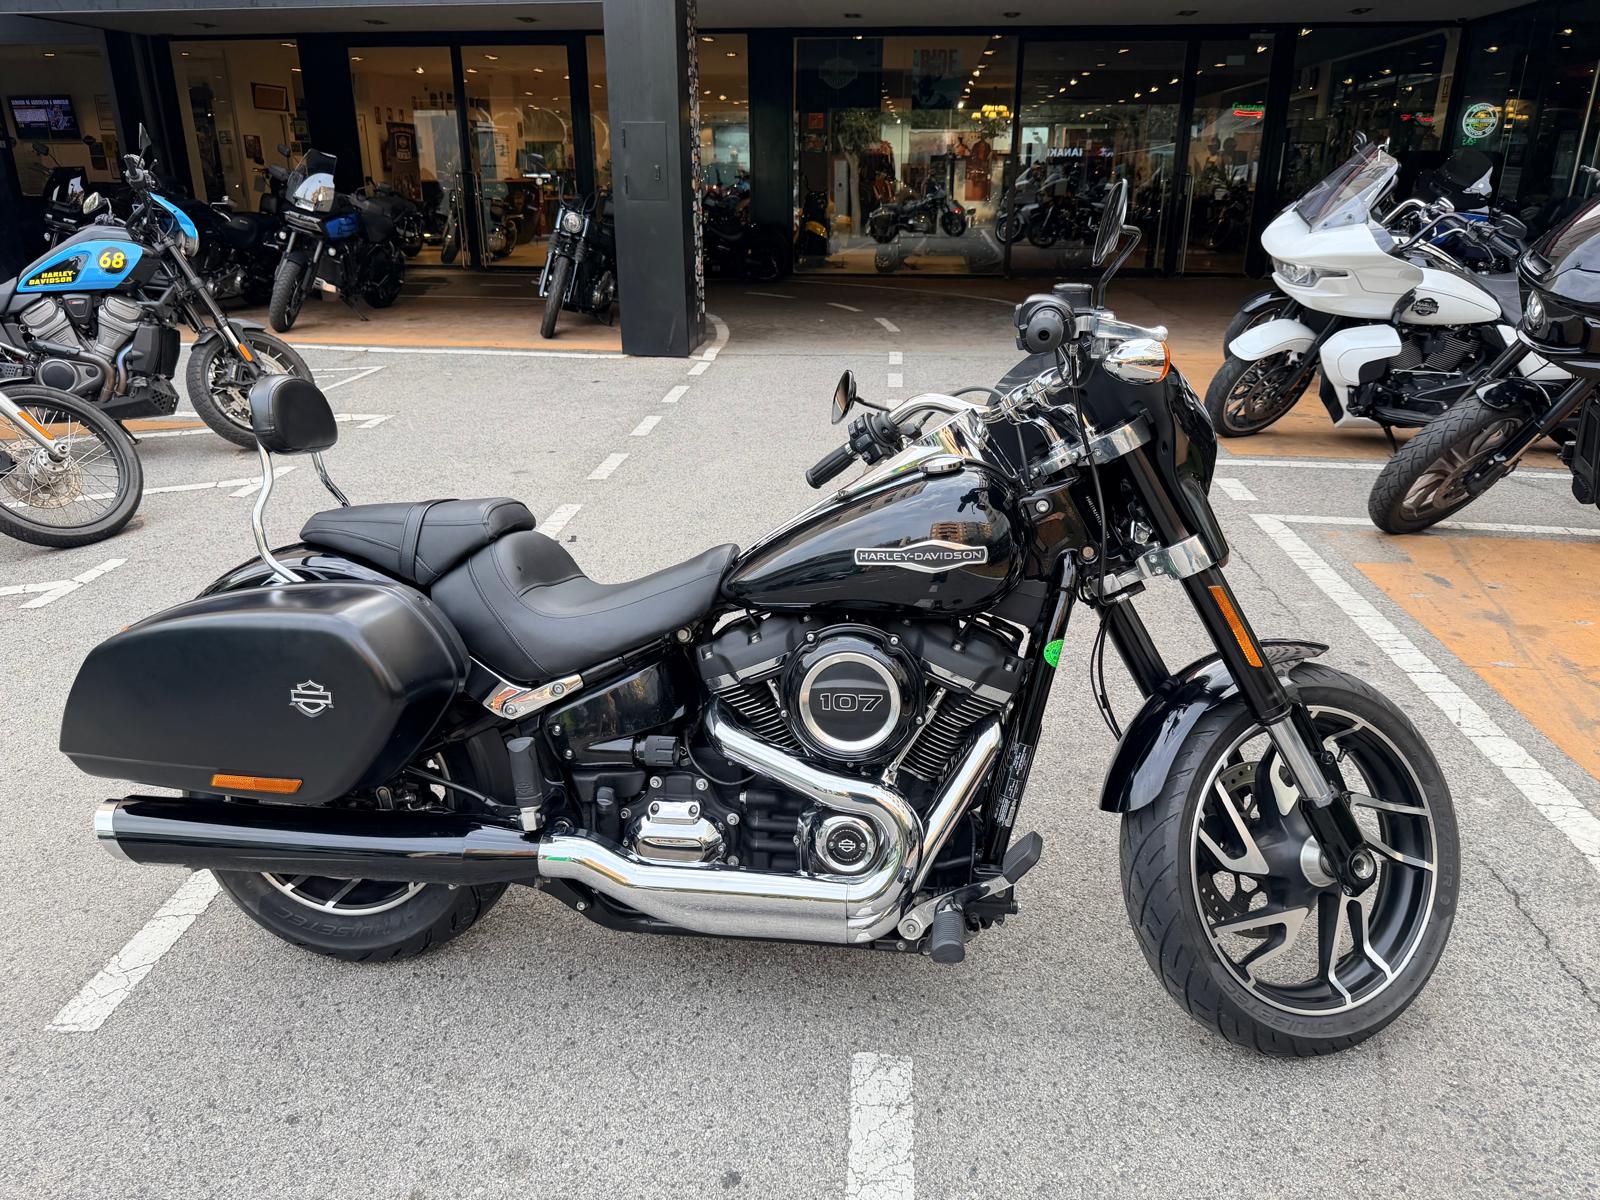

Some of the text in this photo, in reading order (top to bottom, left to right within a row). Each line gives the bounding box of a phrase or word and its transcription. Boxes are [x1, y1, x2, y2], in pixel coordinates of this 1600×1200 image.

[99, 252, 125, 269] 68
[28, 276, 73, 285] DAVIDSON
[859, 551, 982, 561] HARLEY-DAVIDSON
[820, 692, 884, 712] 107
